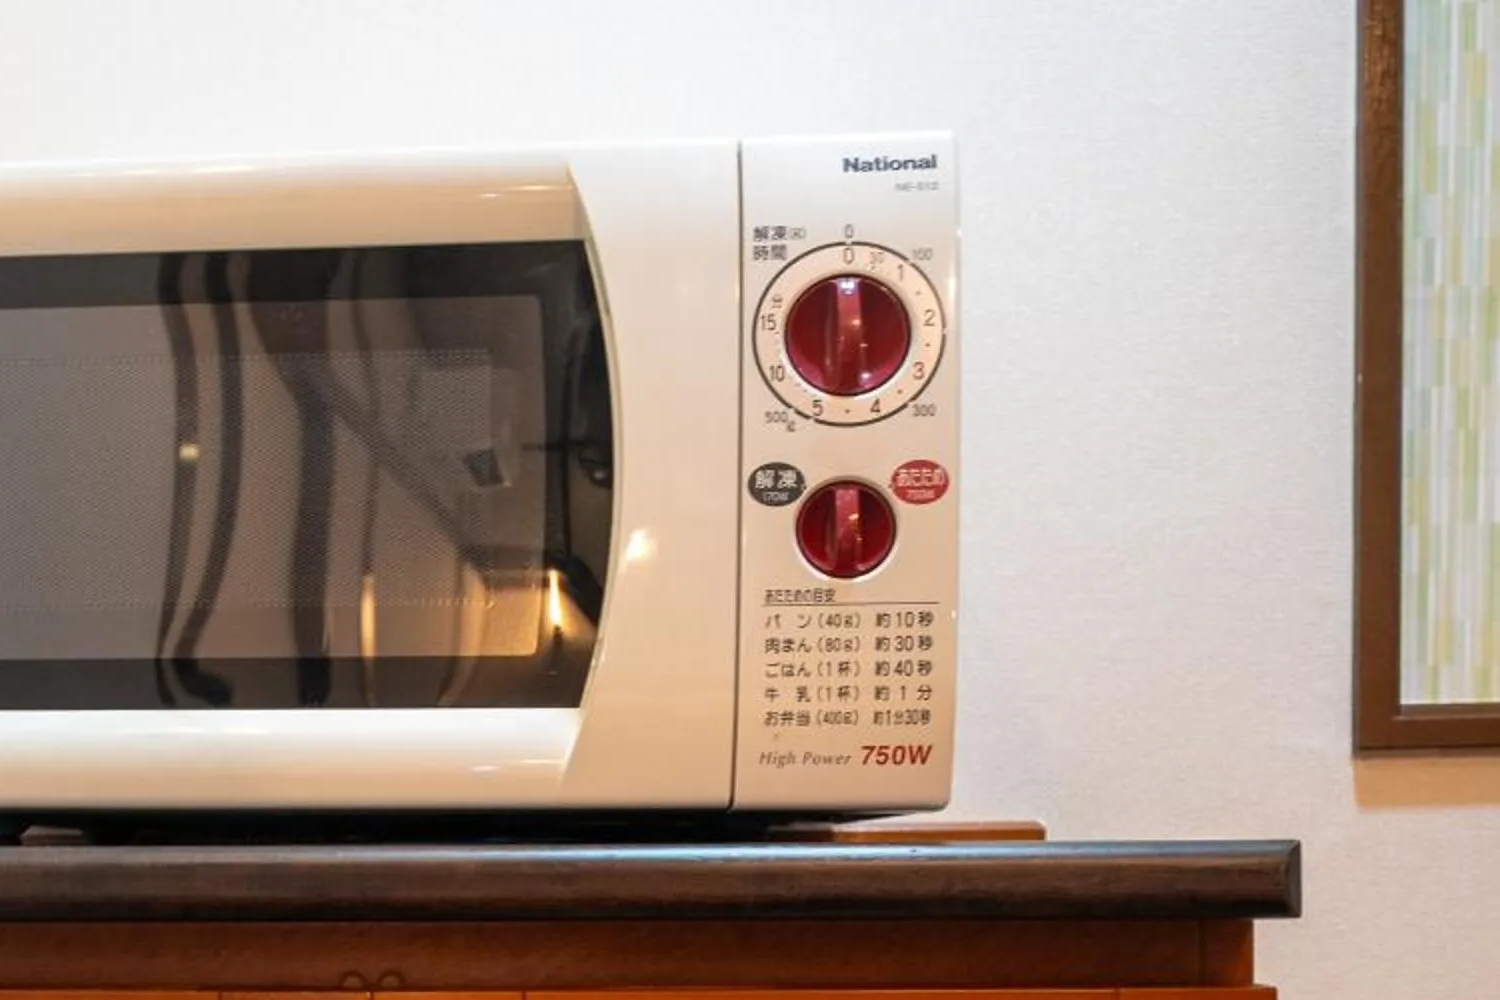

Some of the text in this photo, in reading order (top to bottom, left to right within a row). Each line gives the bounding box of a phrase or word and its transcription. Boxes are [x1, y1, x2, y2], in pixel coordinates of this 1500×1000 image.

[842, 154, 938, 172] National
[845, 223, 854, 239] 0
[843, 247, 854, 264] 0
[760, 313, 777, 331] 15
[923, 309, 935, 327] 2
[769, 365, 785, 382] 10
[912, 361, 925, 380] 3
[812, 400, 823, 417] 5
[869, 400, 881, 415] 4
[912, 405, 936, 418] 300
[755, 469, 798, 489] 解凍
[759, 744, 933, 768] High Power 750W
